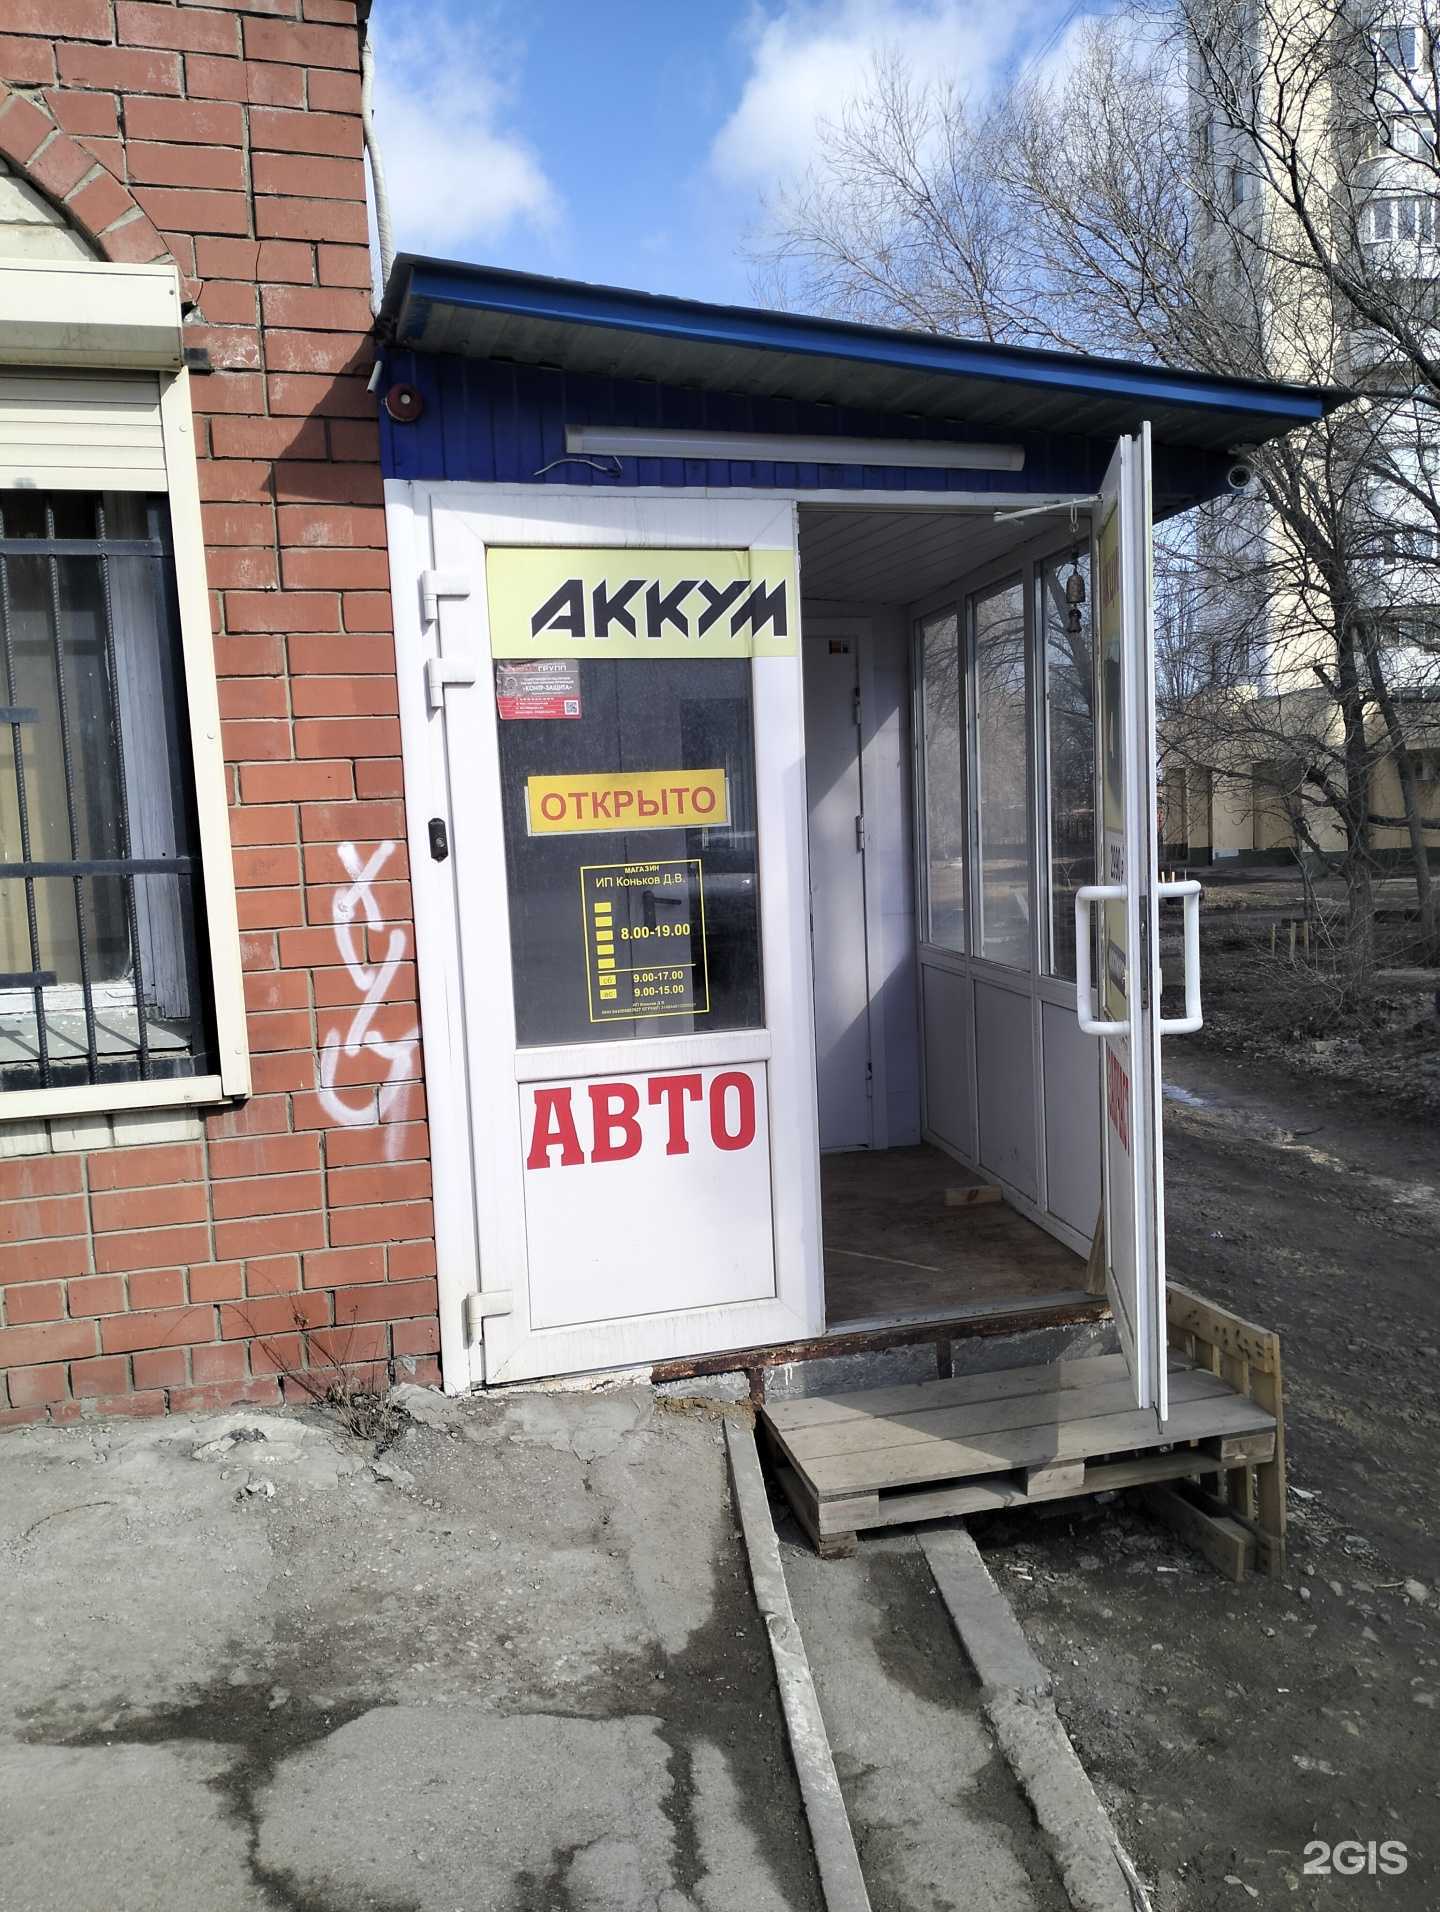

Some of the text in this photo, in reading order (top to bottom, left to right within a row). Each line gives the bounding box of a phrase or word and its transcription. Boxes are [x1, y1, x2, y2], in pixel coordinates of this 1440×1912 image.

[531, 578, 788, 639] АККУМ
[540, 786, 716, 821] ОТКРЫТО
[624, 865, 660, 874] МАГАЗИН
[596, 873, 687, 888] ИП Коньков Д.В.
[620, 923, 691, 940] 8.00-19.00
[633, 970, 684, 983] 9.00-17.00
[634, 984, 685, 997] 9.00-15.00
[527, 1071, 757, 1171] АВТО
